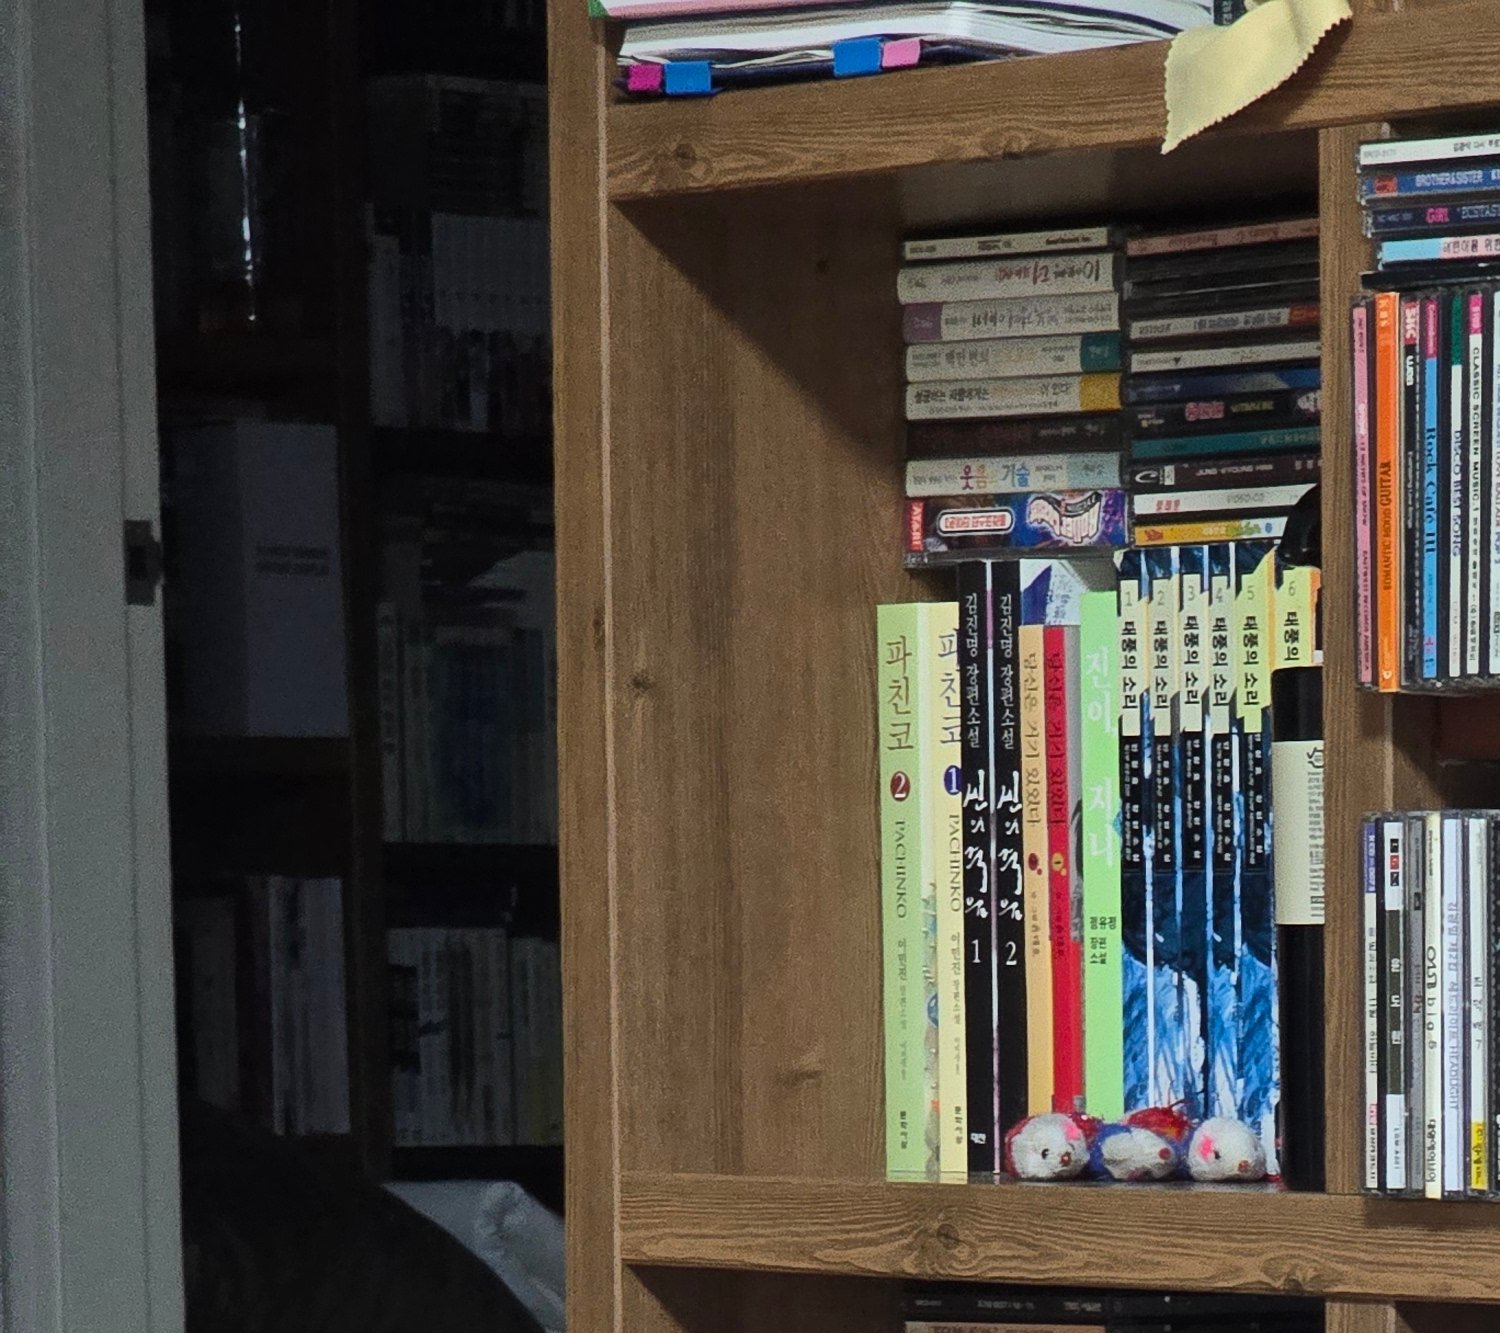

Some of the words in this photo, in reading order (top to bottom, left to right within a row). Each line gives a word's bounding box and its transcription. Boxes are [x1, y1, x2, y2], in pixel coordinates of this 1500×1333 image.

[1426, 427, 1436, 474] Rock
[1453, 430, 1461, 475] DISCO
[1472, 404, 1480, 455] SCREEN
[1380, 461, 1391, 506] GUITAR
[1381, 506, 1391, 538] MOOD
[1453, 515, 1461, 556] SONG
[1382, 540, 1392, 591] ROMANTIC
[1187, 585, 1196, 602] 3
[965, 593, 980, 661] 김진명
[1000, 593, 1014, 660] 김진명
[1122, 621, 1137, 670] 태풍의
[1153, 621, 1168, 669] 태풍의
[1183, 616, 1199, 665] 태풍의
[1213, 617, 1228, 666] 태풍의
[1244, 615, 1260, 665] 태풍의
[1284, 612, 1300, 661] 태풍의
[886, 637, 914, 753] 파친코
[1023, 652, 1038, 712] 당신은
[1122, 676, 1137, 709] 소리
[1153, 676, 1168, 709] 소리
[1183, 672, 1199, 705] 소리
[1212, 673, 1228, 707] 소리
[1244, 672, 1259, 706] 소리
[967, 665, 981, 749] 장편소설
[1001, 665, 1015, 749] 장편소설
[1025, 721, 1039, 758] 거기
[894, 774, 907, 797] 2
[1026, 768, 1040, 825] 있었다
[1089, 777, 1113, 868] 지니
[895, 820, 905, 918] PACHINKO
[950, 814, 961, 912] PACHINKO
[972, 940, 981, 965] 1
[1005, 941, 1016, 966] 2
[1449, 1046, 1458, 1110] HEADLIGHT
